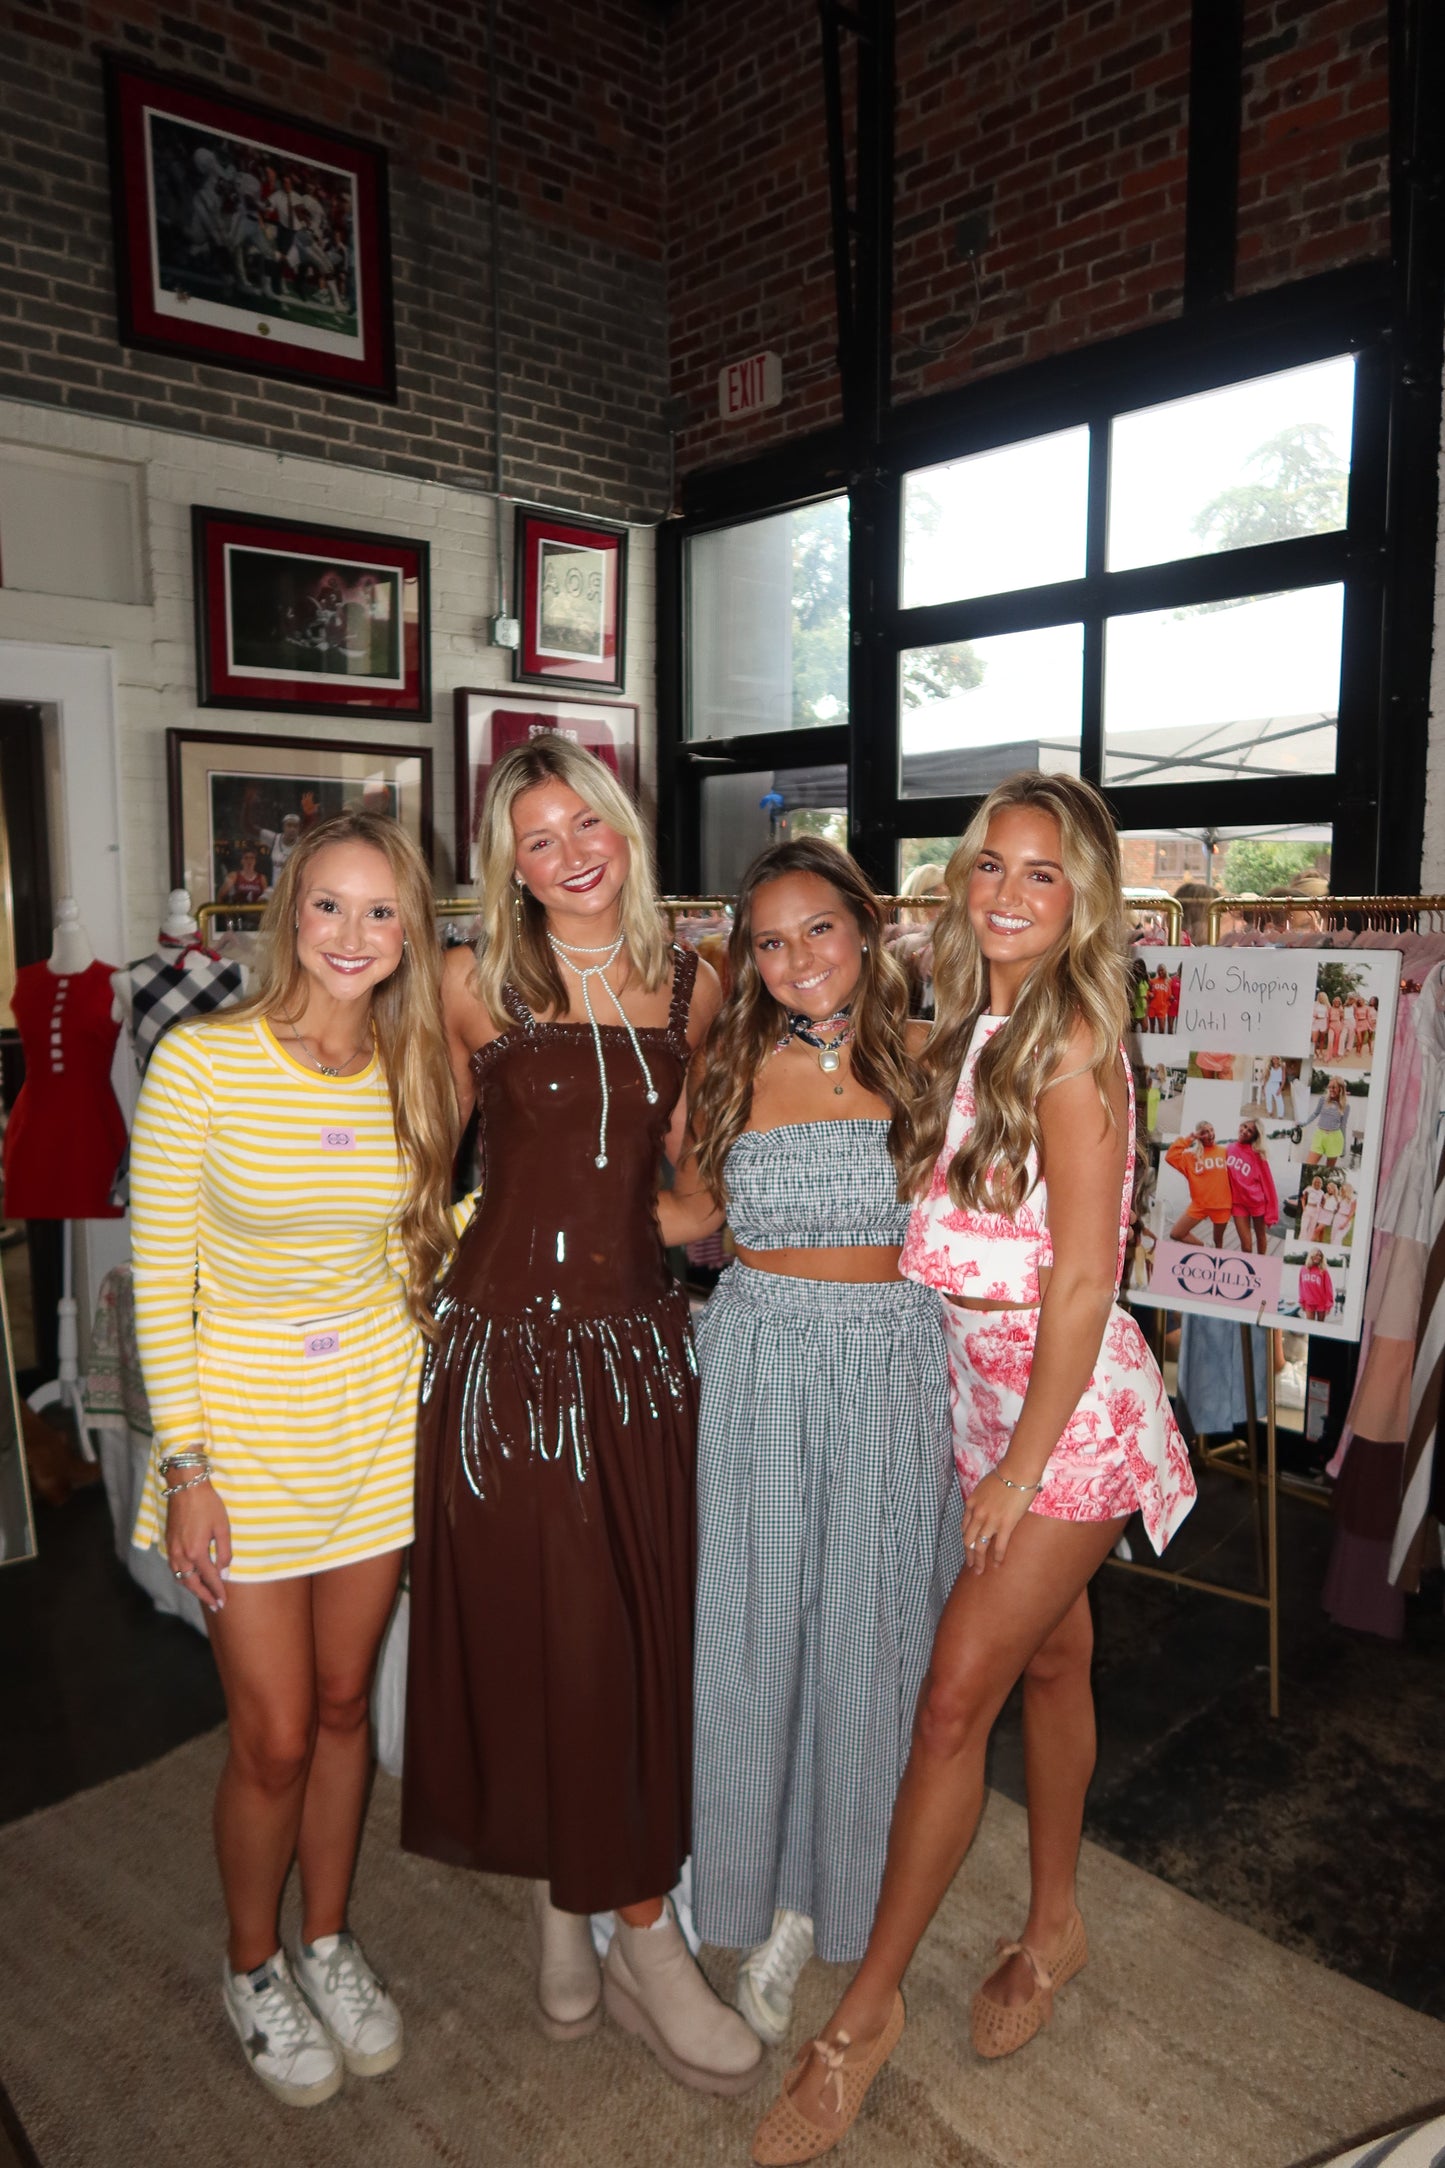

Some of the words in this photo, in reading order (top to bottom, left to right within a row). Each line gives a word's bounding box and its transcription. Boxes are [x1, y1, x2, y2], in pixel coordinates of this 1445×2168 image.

[728, 355, 766, 412] EXIT
[1189, 963, 1215, 992] No
[1226, 966, 1298, 1006] Shopping
[1186, 1008, 1226, 1032] Until
[1241, 1011, 1261, 1032] 9!
[1171, 1264, 1262, 1288] COCOLILLYS
